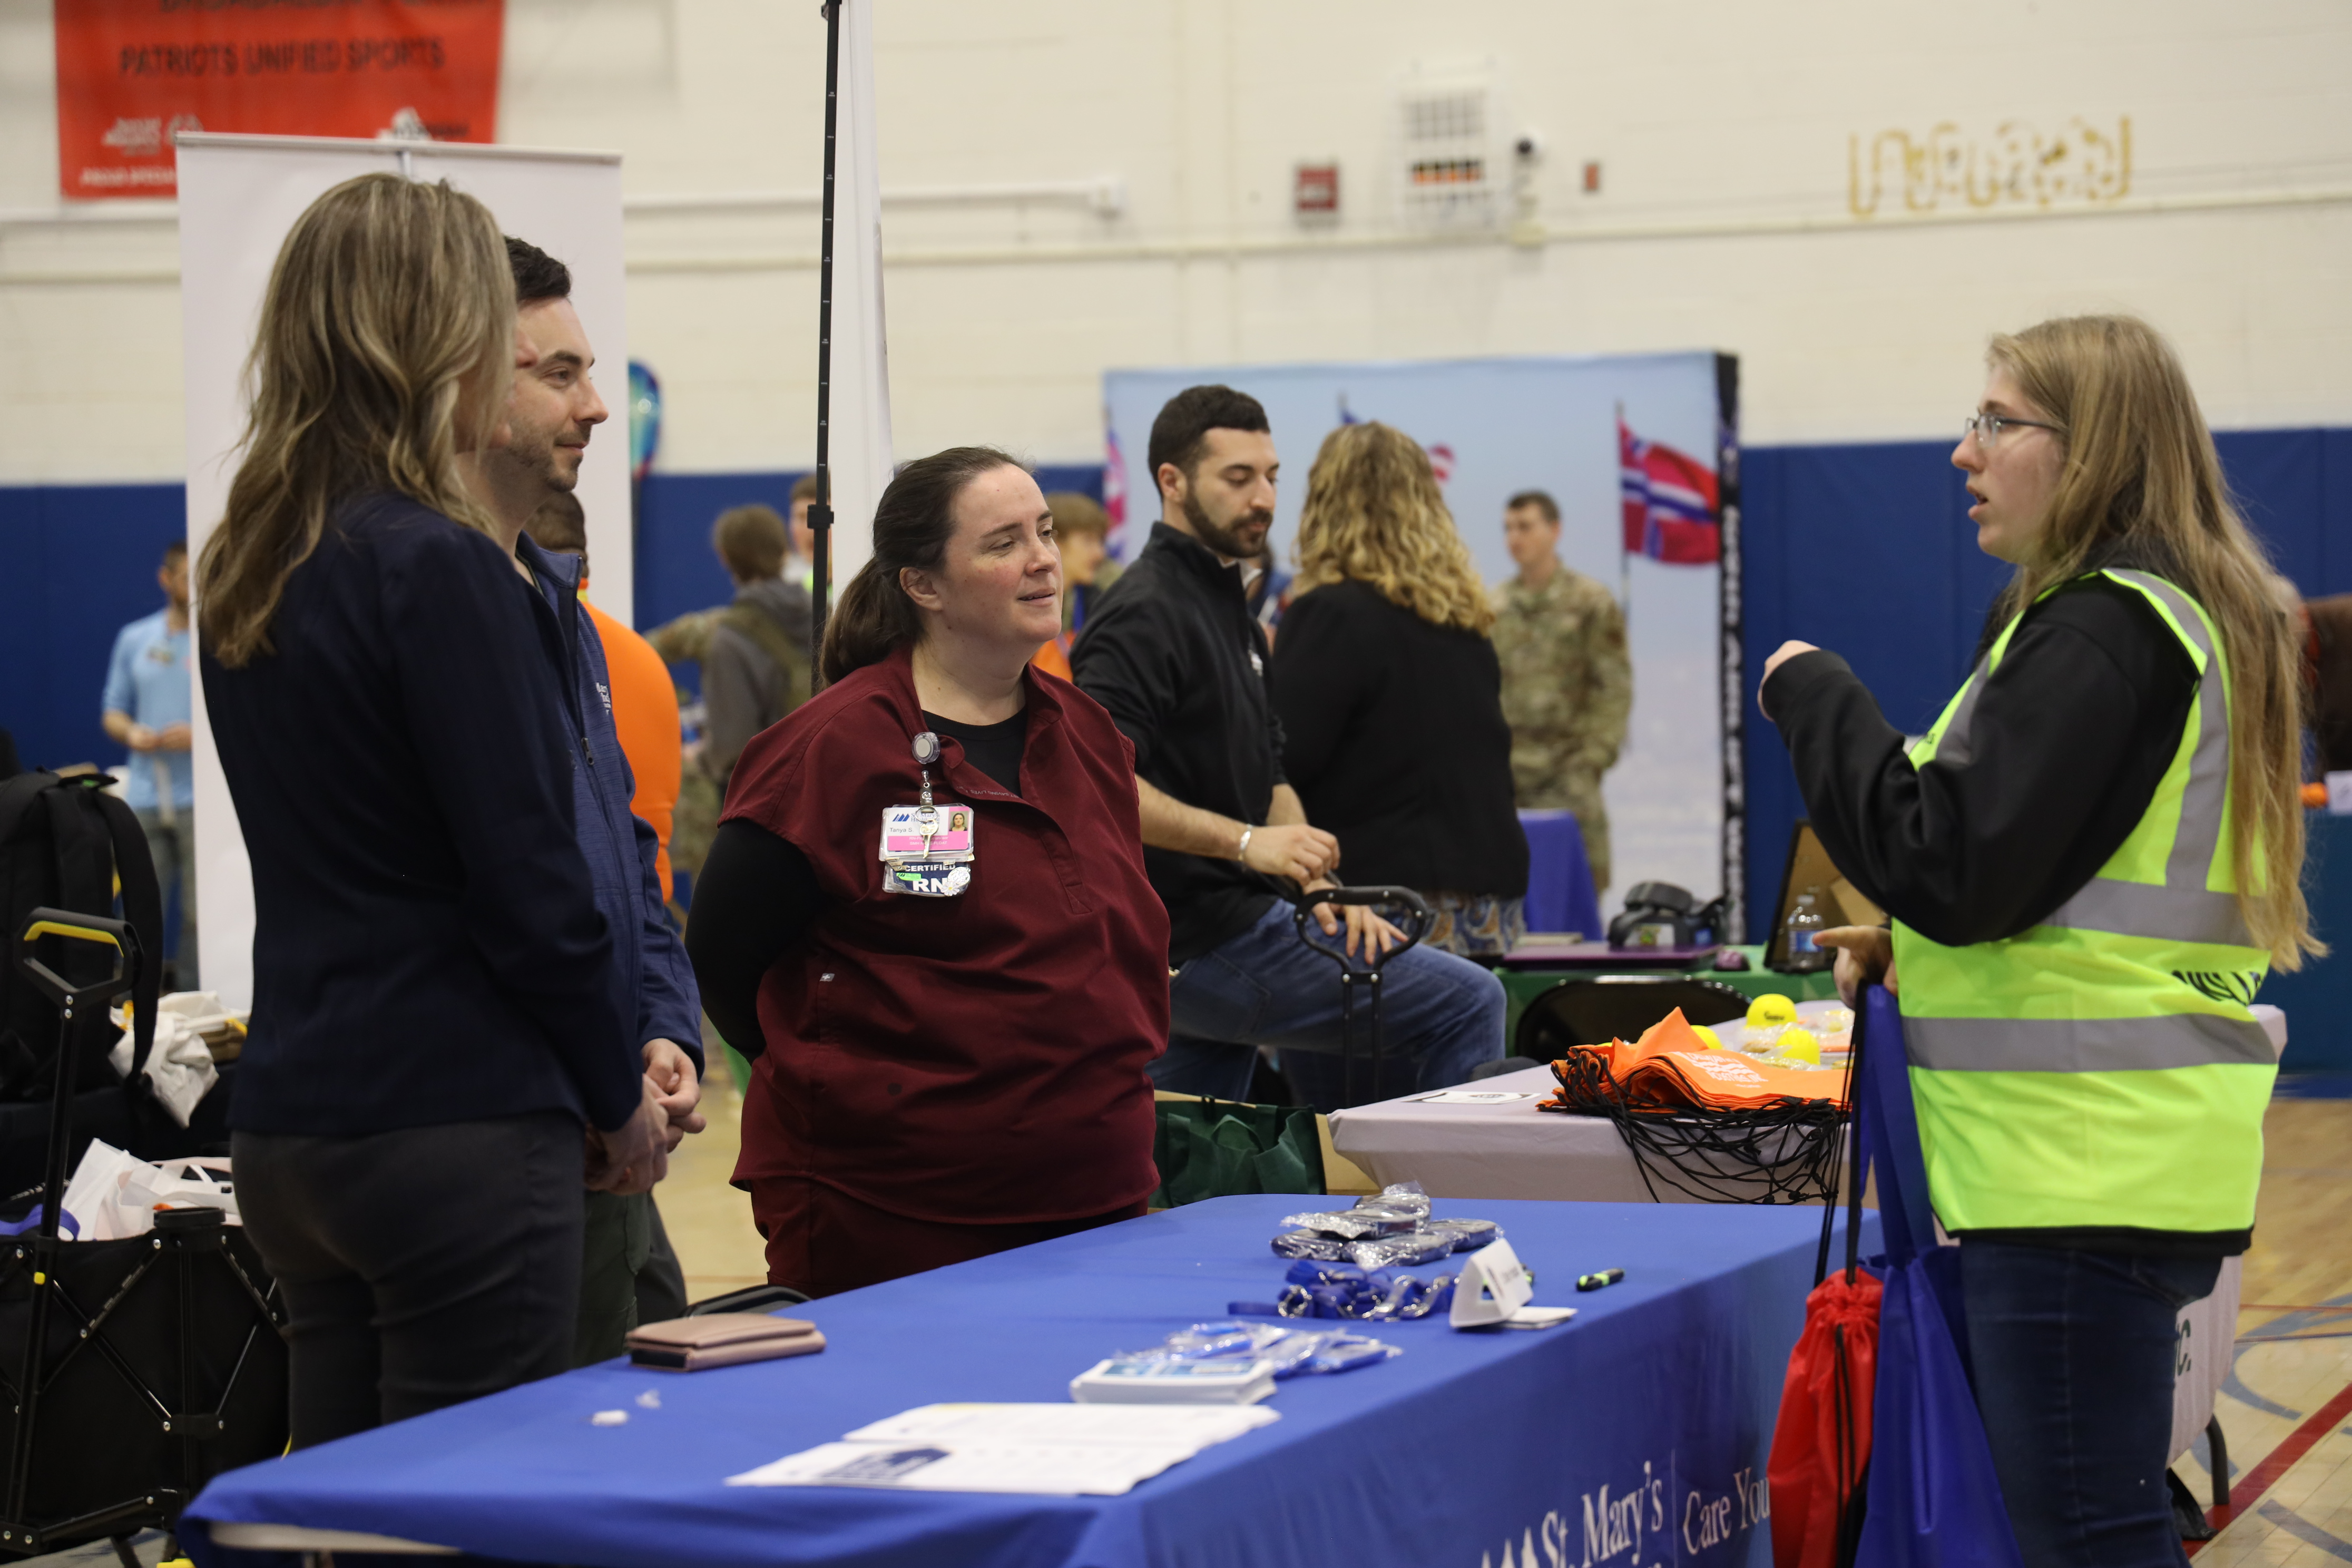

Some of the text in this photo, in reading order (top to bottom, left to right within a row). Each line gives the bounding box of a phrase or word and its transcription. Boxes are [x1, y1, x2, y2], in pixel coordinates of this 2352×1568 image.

[120, 36, 445, 77] PATRIOTS UNIFIED SPORTS
[913, 877, 948, 893] RN
[1582, 1460, 1662, 1568] Mary's
[1683, 1491, 1732, 1555] Care
